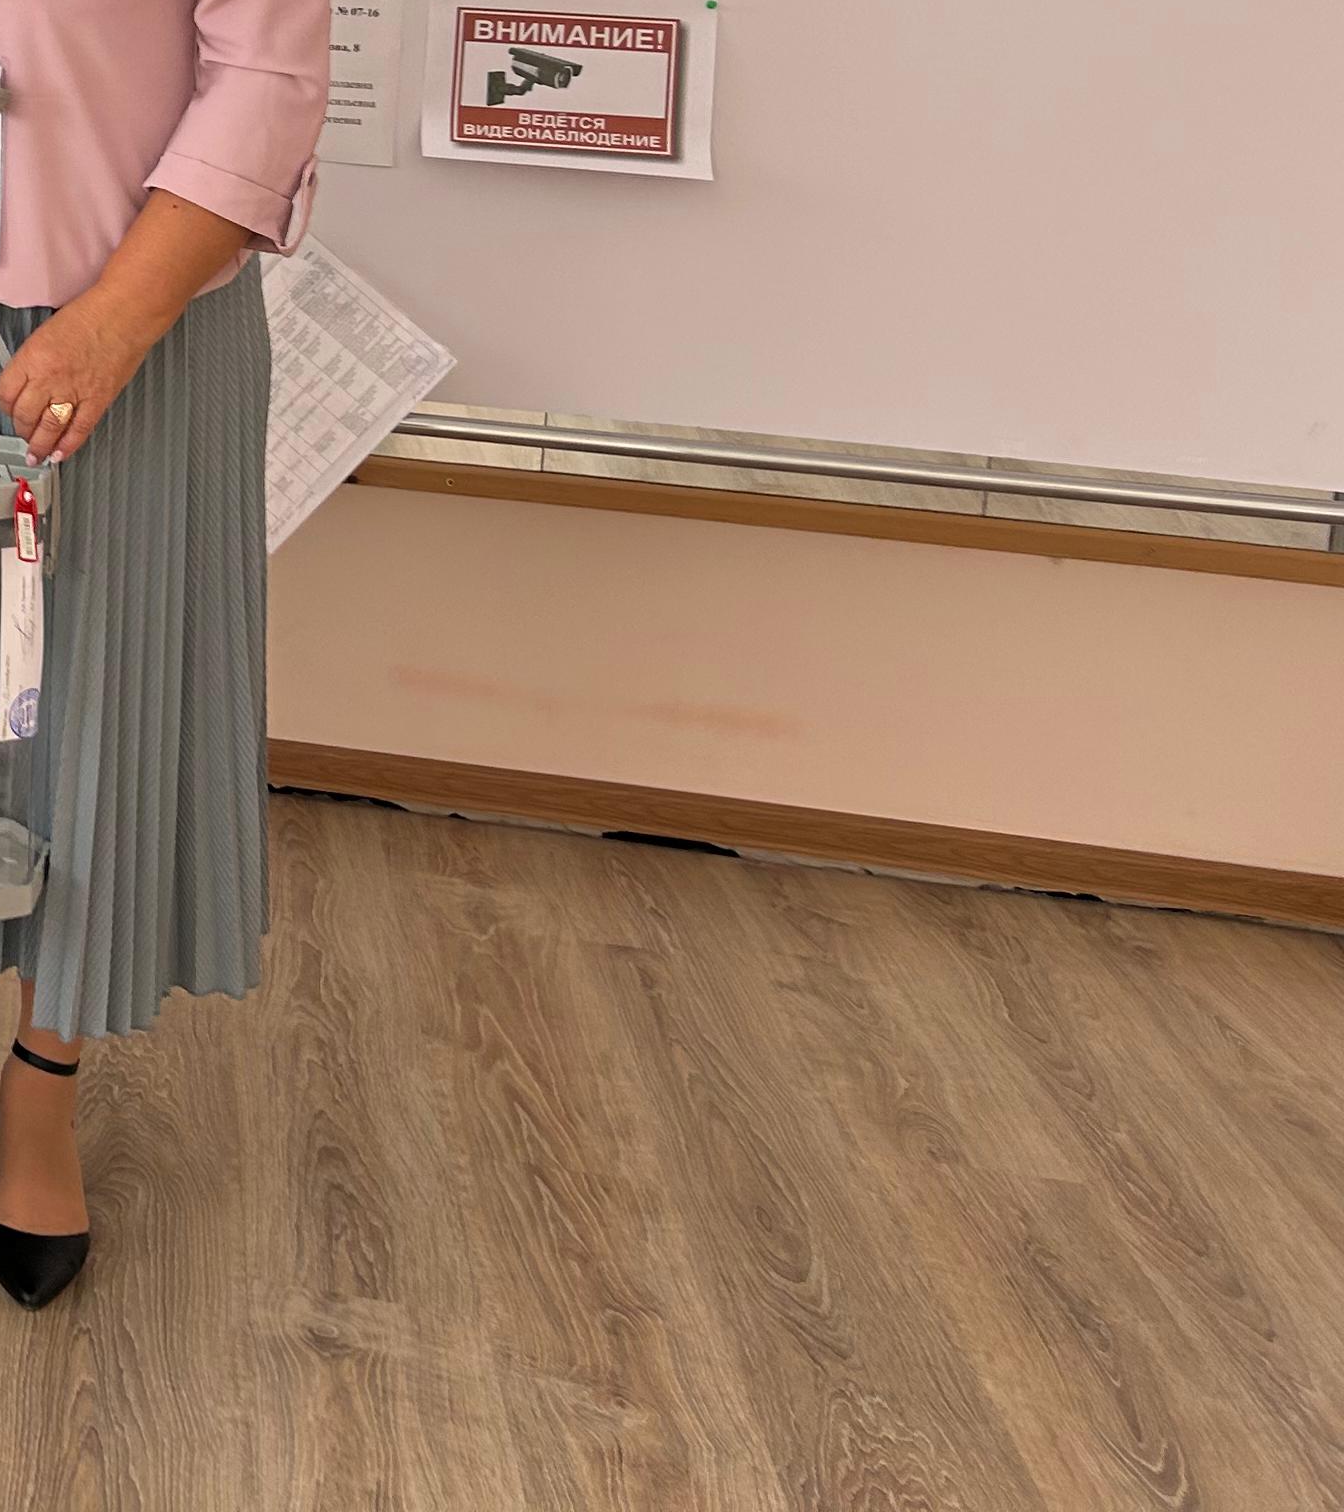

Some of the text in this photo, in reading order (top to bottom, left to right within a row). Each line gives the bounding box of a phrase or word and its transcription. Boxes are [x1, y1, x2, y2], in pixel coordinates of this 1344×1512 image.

[350, 7, 380, 17] 07-16
[473, 19, 665, 49] ВНИМАНИЕ!
[519, 112, 605, 130] ВЕДЁТСЯ
[463, 123, 660, 148] ВИДЕОНАБЛЮДЕНИЕ
